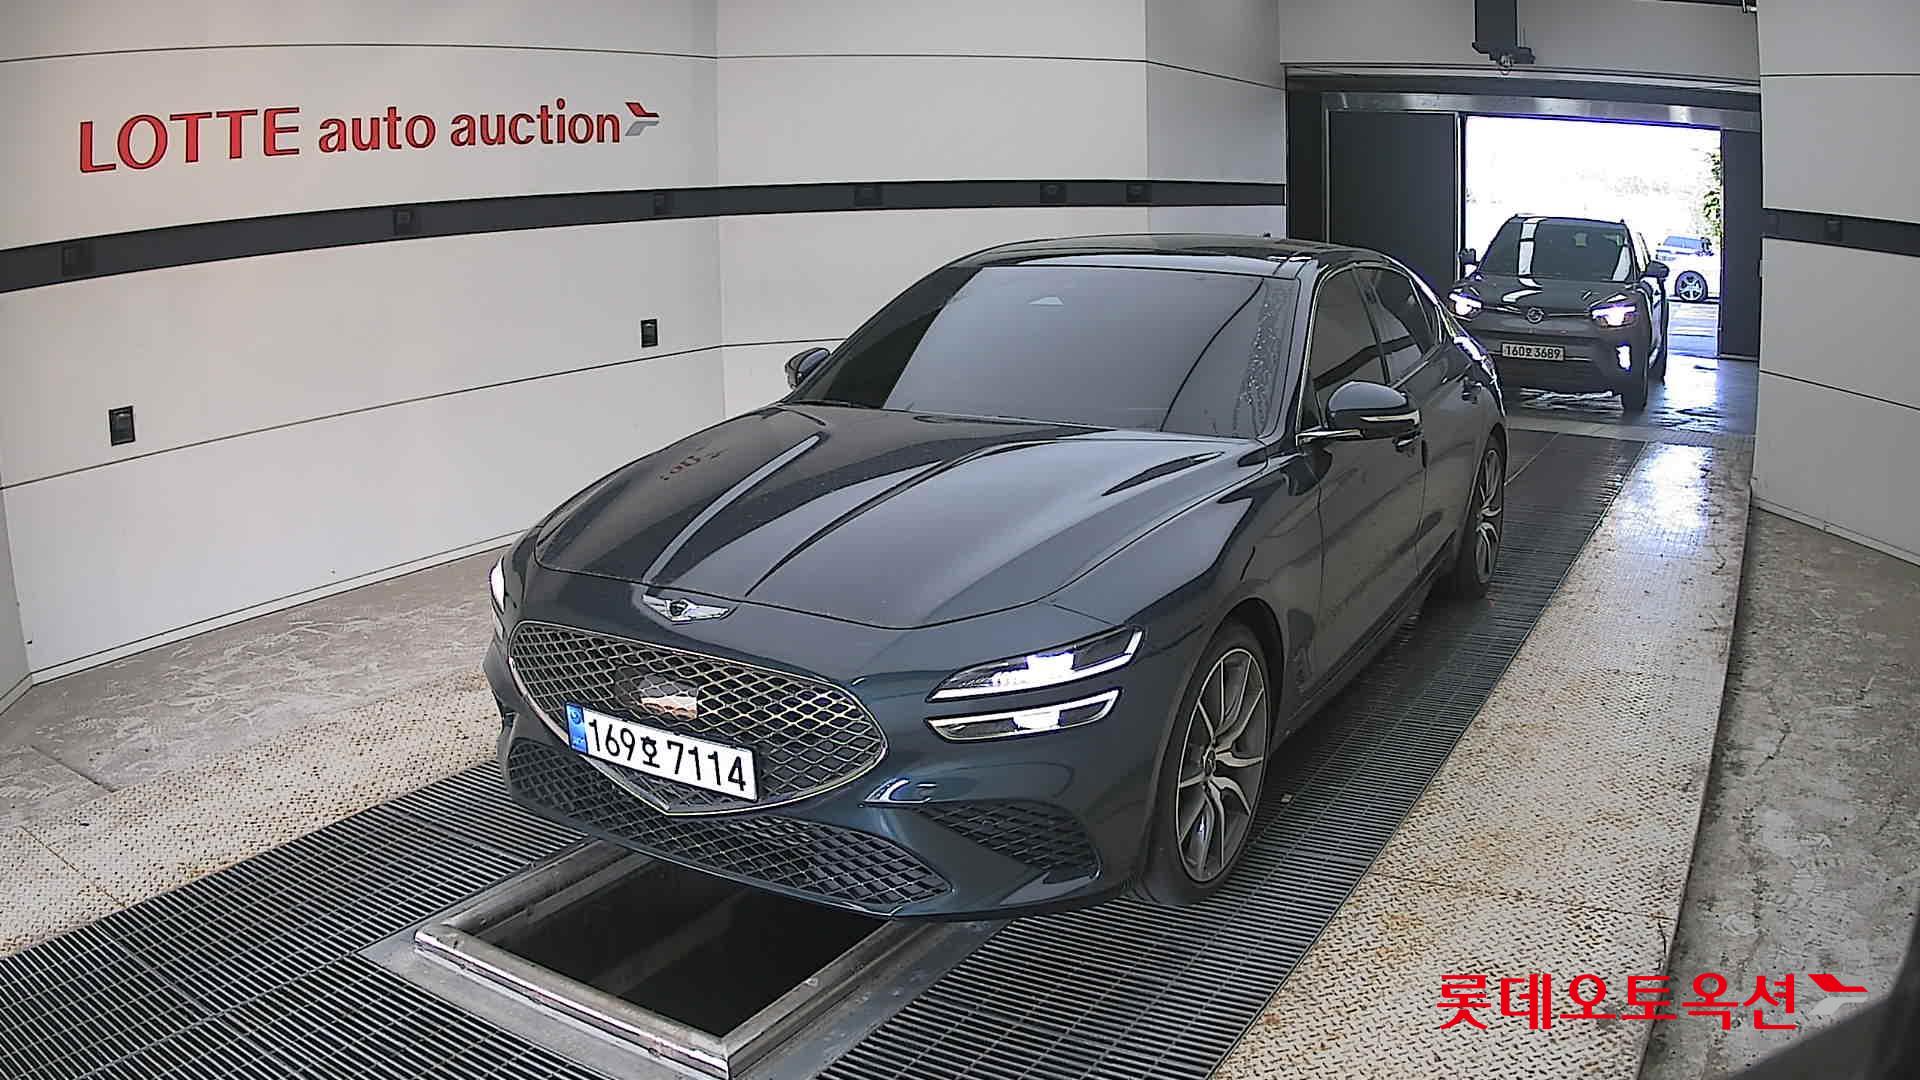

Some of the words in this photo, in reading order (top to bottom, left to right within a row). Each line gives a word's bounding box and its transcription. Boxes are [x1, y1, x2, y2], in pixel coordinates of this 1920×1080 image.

[79, 106, 300, 174] LOTTE
[318, 106, 437, 153] auto
[450, 98, 621, 146] auction
[1534, 347, 1561, 359] 3689
[588, 719, 660, 769] 169호
[666, 740, 747, 792] 7114
